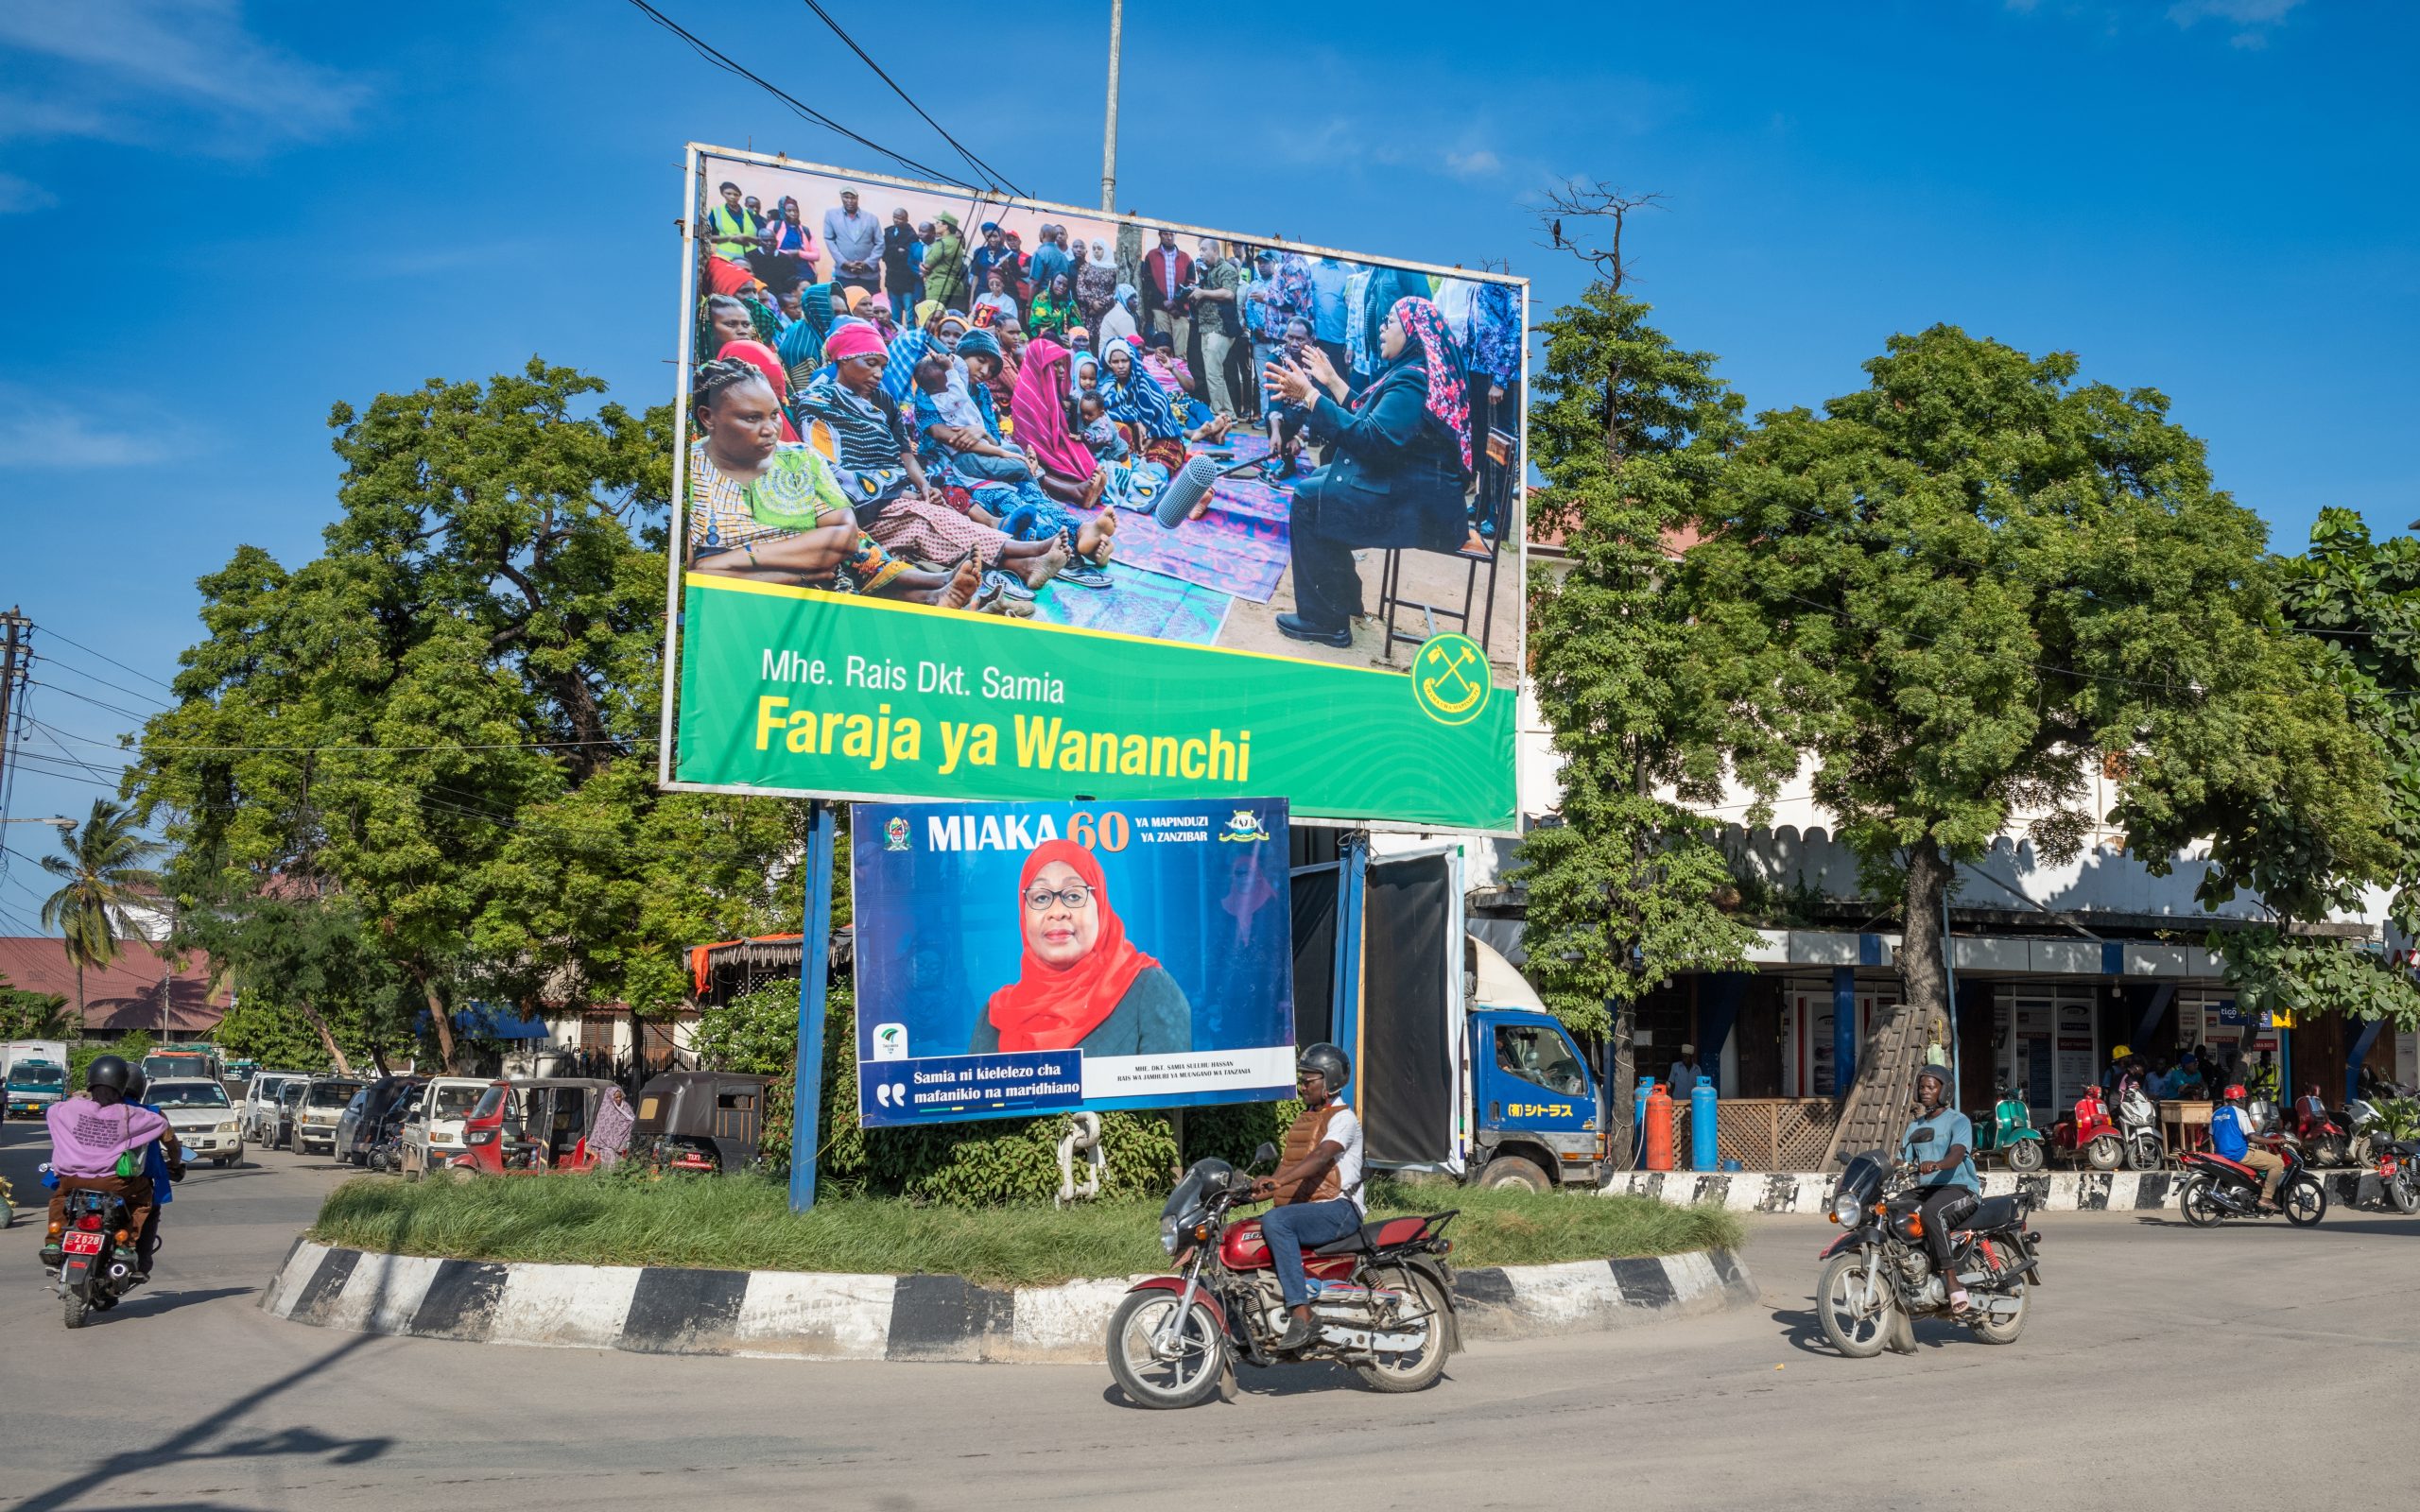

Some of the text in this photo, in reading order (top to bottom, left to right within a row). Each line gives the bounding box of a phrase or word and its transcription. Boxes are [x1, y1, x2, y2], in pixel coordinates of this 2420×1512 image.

[762, 648, 1064, 704] Mhe. Rais Dkt. Samia
[755, 695, 1252, 782] Faraja ya Wananchi
[927, 811, 1131, 853] MIAKA 60
[1134, 816, 1209, 829] YA MAPINDUZI
[1140, 831, 1208, 844] YA ZANZIBAR
[913, 1063, 1062, 1085] Samia ni kielelezo cha
[914, 1082, 1080, 1104] mafanikio na maridhiano
[1508, 1103, 1574, 1117] (有)シトラス
